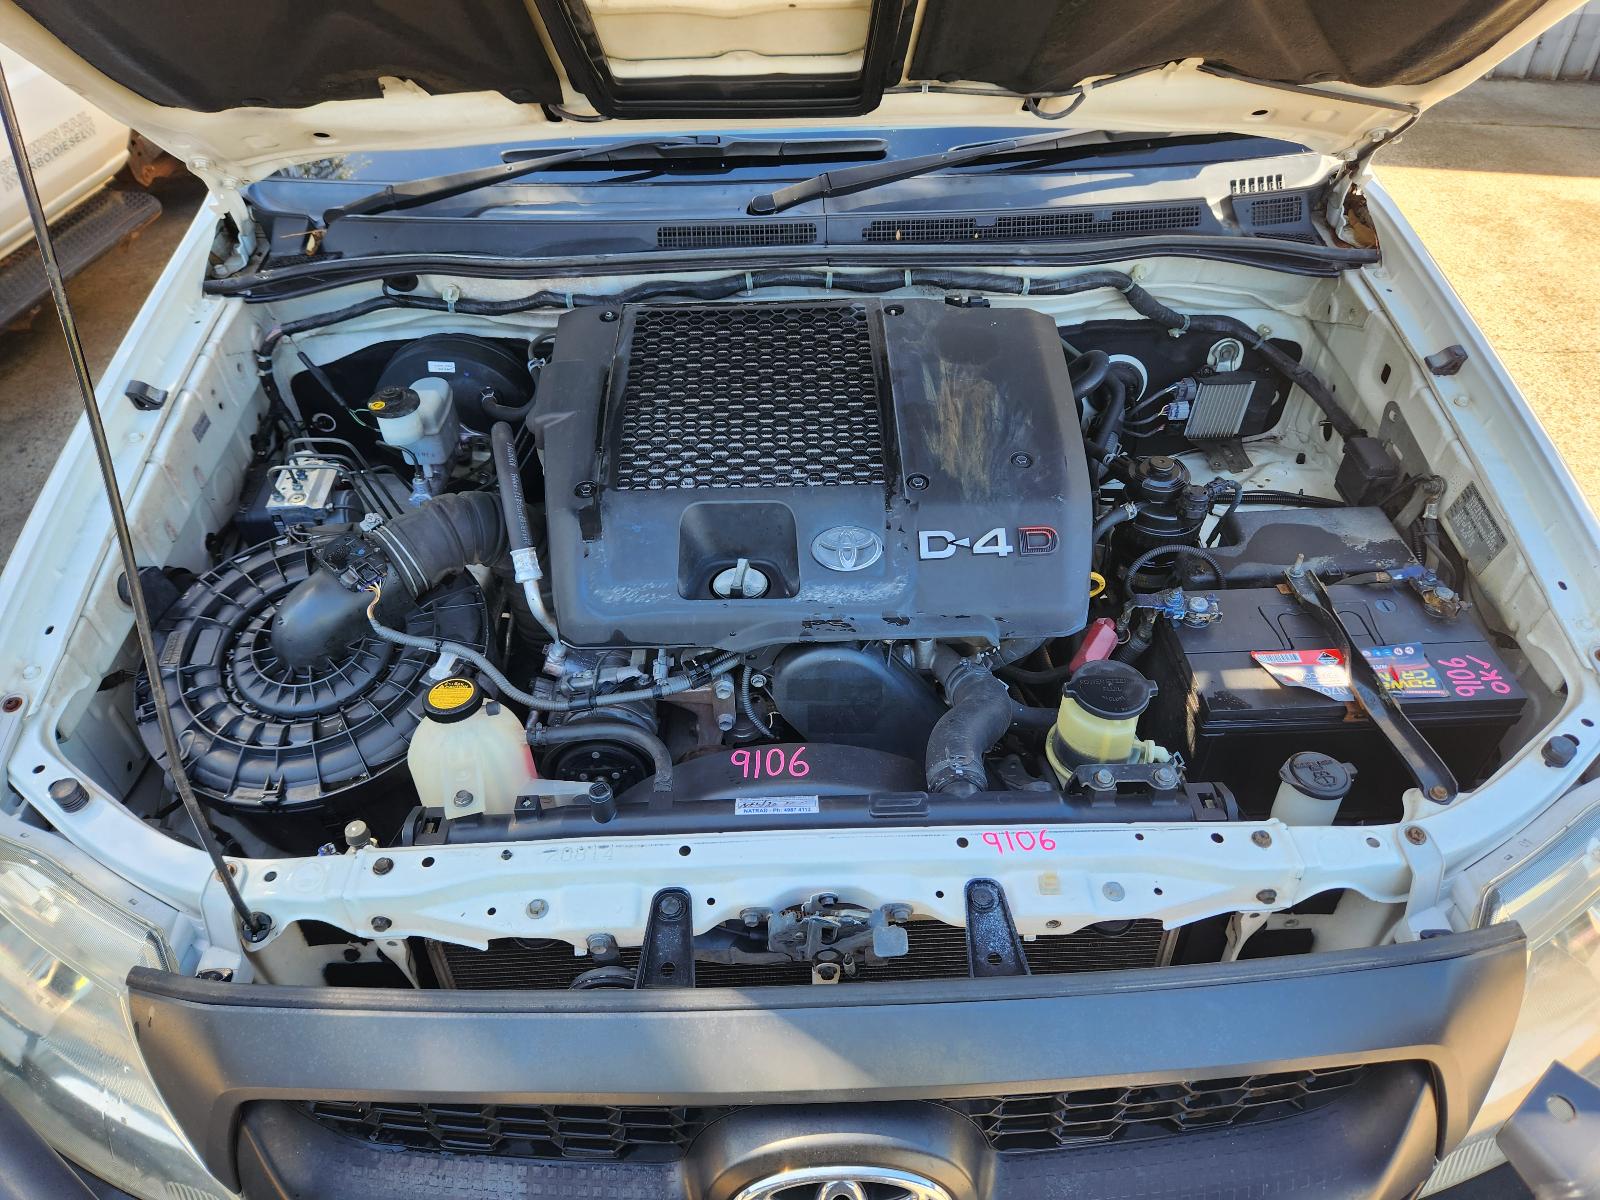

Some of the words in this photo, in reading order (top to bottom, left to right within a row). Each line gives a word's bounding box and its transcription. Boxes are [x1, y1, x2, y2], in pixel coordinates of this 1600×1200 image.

[918, 526, 1060, 560] D-4D
[1437, 655, 1486, 698] 9106
[730, 746, 810, 778] 9106
[982, 829, 1057, 855] 9106
